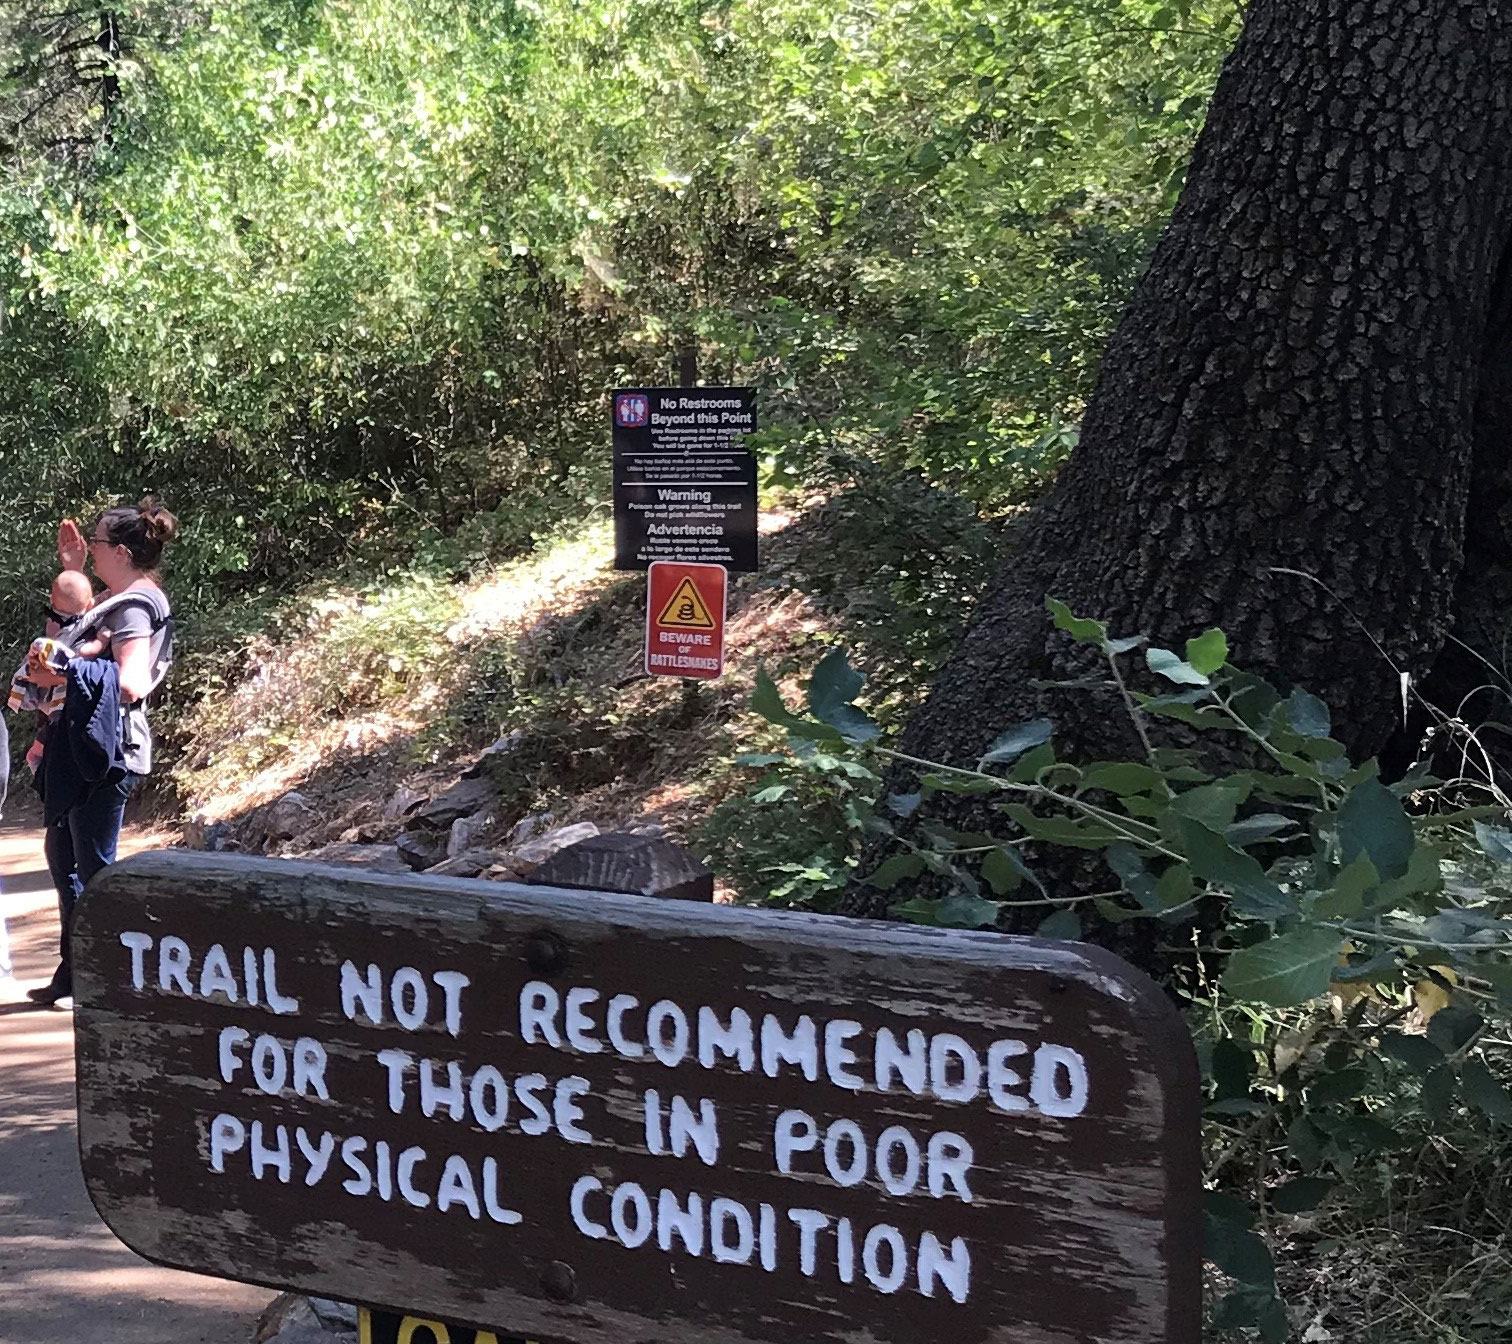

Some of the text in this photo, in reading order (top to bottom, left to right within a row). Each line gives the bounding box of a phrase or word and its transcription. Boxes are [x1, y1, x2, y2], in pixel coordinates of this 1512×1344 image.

[660, 397, 742, 409] No Restrooms
[651, 412, 752, 426] Beyond this Point
[658, 488, 712, 503] Warning
[647, 523, 724, 536] Advertencia
[659, 632, 712, 645] BEWARE
[678, 645, 692, 654] OF
[650, 654, 718, 670] RATTLESNAKES
[118, 930, 1090, 1119] TRAIL NOT RECOMMENDED
[218, 1024, 976, 1204] FOR THOSE IN POOR
[209, 1112, 972, 1306] PHYSICAL CONDITION
